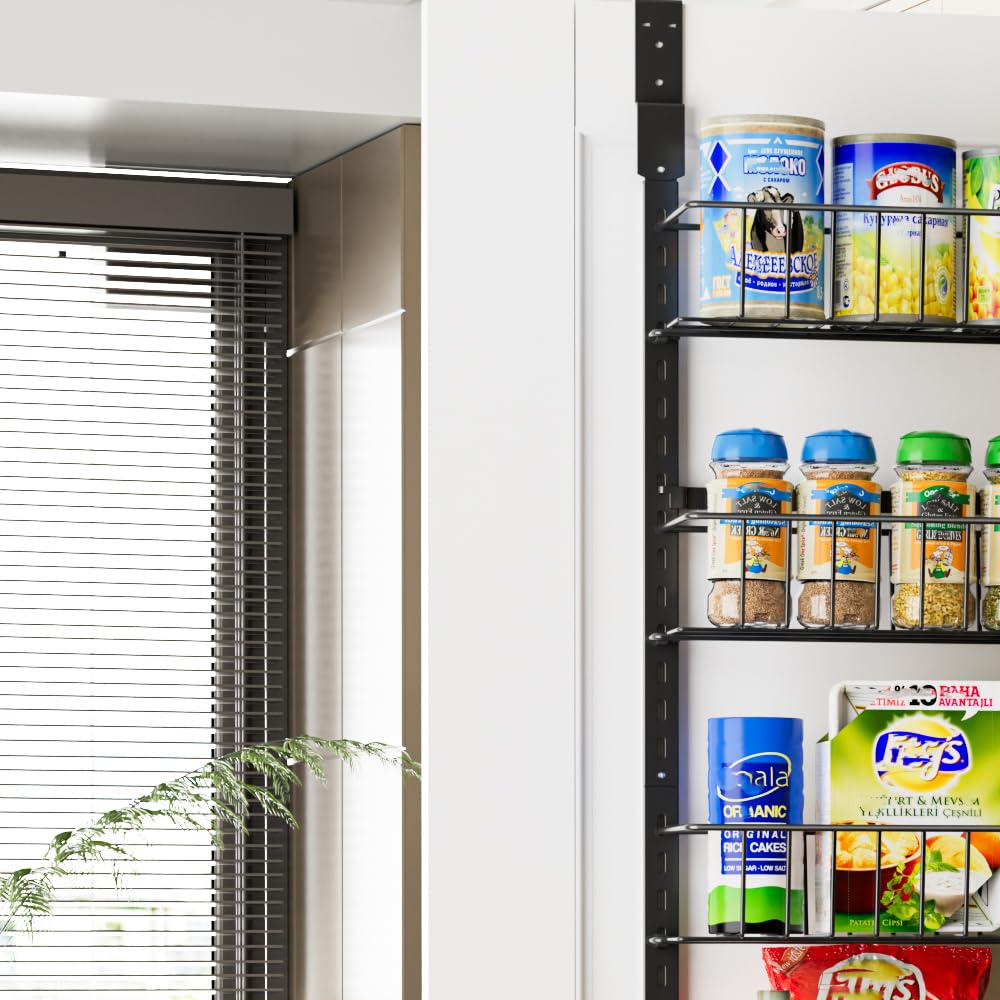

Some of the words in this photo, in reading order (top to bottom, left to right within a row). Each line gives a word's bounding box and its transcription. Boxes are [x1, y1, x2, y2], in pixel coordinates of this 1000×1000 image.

[912, 214, 949, 228] саарная
[917, 796, 927, 806] &
[723, 805, 787, 818] ORANIC
[724, 830, 787, 839] ORGINAL
[723, 842, 743, 853] RIC
[749, 842, 787, 853] CAKES
